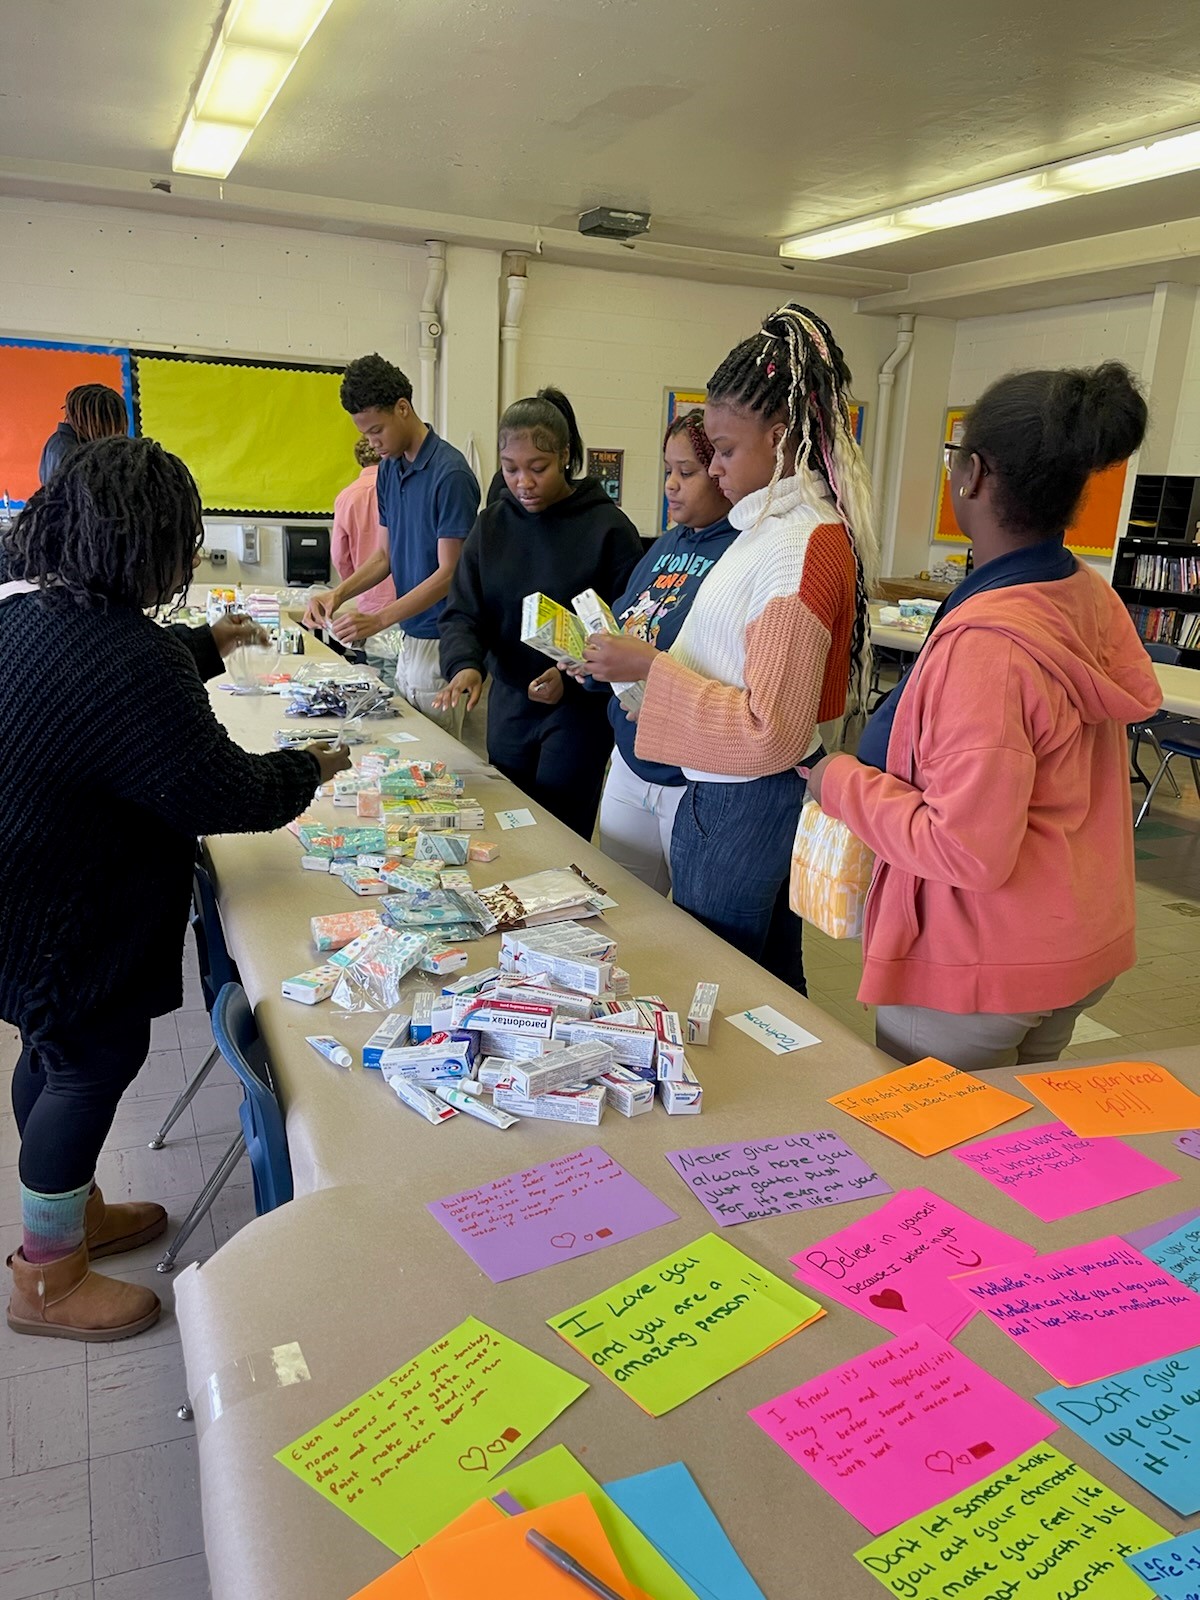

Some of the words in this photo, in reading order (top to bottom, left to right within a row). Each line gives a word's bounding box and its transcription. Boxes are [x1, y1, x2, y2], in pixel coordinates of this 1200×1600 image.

[491, 1016, 547, 1028] parodontax
[678, 1149, 733, 1172] Never
[743, 1143, 779, 1160] give
[784, 1136, 815, 1150] up
[692, 1164, 760, 1186] always
[768, 1156, 814, 1170] hope
[817, 1149, 854, 1162] you
[992, 1142, 1031, 1157] hard
[520, 1170, 538, 1182] get
[848, 1172, 878, 1189] your
[461, 1222, 480, 1232] and
[520, 1201, 542, 1212] what
[548, 1194, 564, 1204] you
[786, 1201, 803, 1211] in
[806, 1238, 876, 1280] Believe
[880, 1234, 896, 1246] in
[898, 1202, 936, 1236] yourself
[842, 1270, 891, 1295] because
[886, 1263, 902, 1274] I
[900, 1244, 930, 1264] believe
[936, 1226, 958, 1242] you
[557, 1310, 605, 1338] I
[606, 1284, 658, 1318] Love
[658, 1256, 701, 1286] you
[968, 1276, 1027, 1300] Motivation
[1046, 1264, 1077, 1281] what
[1076, 1262, 1097, 1276] you
[988, 1299, 1043, 1320] Motivation
[1058, 1289, 1091, 1302] take
[1089, 1288, 1111, 1302] you
[1111, 1286, 1120, 1294] a
[1118, 1281, 1148, 1294] long
[1144, 1277, 1170, 1288] way
[591, 1339, 628, 1367] and
[629, 1316, 668, 1346] you
[674, 1293, 708, 1316] are
[709, 1280, 723, 1291] a
[1008, 1324, 1030, 1337] and
[1034, 1316, 1067, 1328] hope
[1066, 1309, 1094, 1322] this
[1119, 1298, 1166, 1313] motivate
[614, 1332, 698, 1382] amazing
[291, 1434, 324, 1461] Even
[333, 1406, 361, 1429] when
[370, 1390, 386, 1402] it
[430, 1339, 451, 1356] like
[352, 1414, 378, 1438] cares
[386, 1399, 398, 1411] or
[430, 1362, 450, 1382] you
[453, 1332, 491, 1360] somebody
[858, 1386, 880, 1404] and
[1056, 1380, 1141, 1426] Don't
[1143, 1360, 1190, 1393] give
[316, 1462, 340, 1483] does
[349, 1443, 368, 1461] and
[374, 1421, 398, 1441] when
[402, 1404, 421, 1422] you
[428, 1373, 460, 1404] gotta
[465, 1346, 488, 1370] make
[491, 1339, 501, 1348] a
[768, 1408, 787, 1424] I
[803, 1442, 825, 1462] get
[836, 1418, 868, 1440] better
[914, 1391, 926, 1400] or
[930, 1376, 952, 1392] later
[864, 1428, 886, 1444] wait
[898, 1411, 917, 1426] and
[922, 1397, 950, 1413] watch
[952, 1384, 972, 1398] and
[1104, 1427, 1146, 1448] up
[1136, 1403, 1180, 1436] you
[346, 1486, 364, 1504] see
[441, 1402, 465, 1426] hear
[372, 1438, 404, 1464] make
[410, 1418, 426, 1431] it
[870, 1442, 894, 1460] hard
[862, 1538, 922, 1574] Don't
[920, 1514, 954, 1539] let
[952, 1473, 1022, 1520] someone
[1016, 1452, 1056, 1474] take
[890, 1562, 937, 1599] you
[939, 1536, 970, 1562] out
[973, 1504, 1017, 1542] your
[942, 1560, 998, 1600] make
[1000, 1533, 1040, 1562] you
[1040, 1506, 1076, 1531] feel
[1071, 1486, 1104, 1508] like
[1026, 1538, 1080, 1582] worth
[1075, 1523, 1098, 1540] it
[1057, 1561, 1115, 1600] worth
[1132, 1557, 1184, 1582] Life
